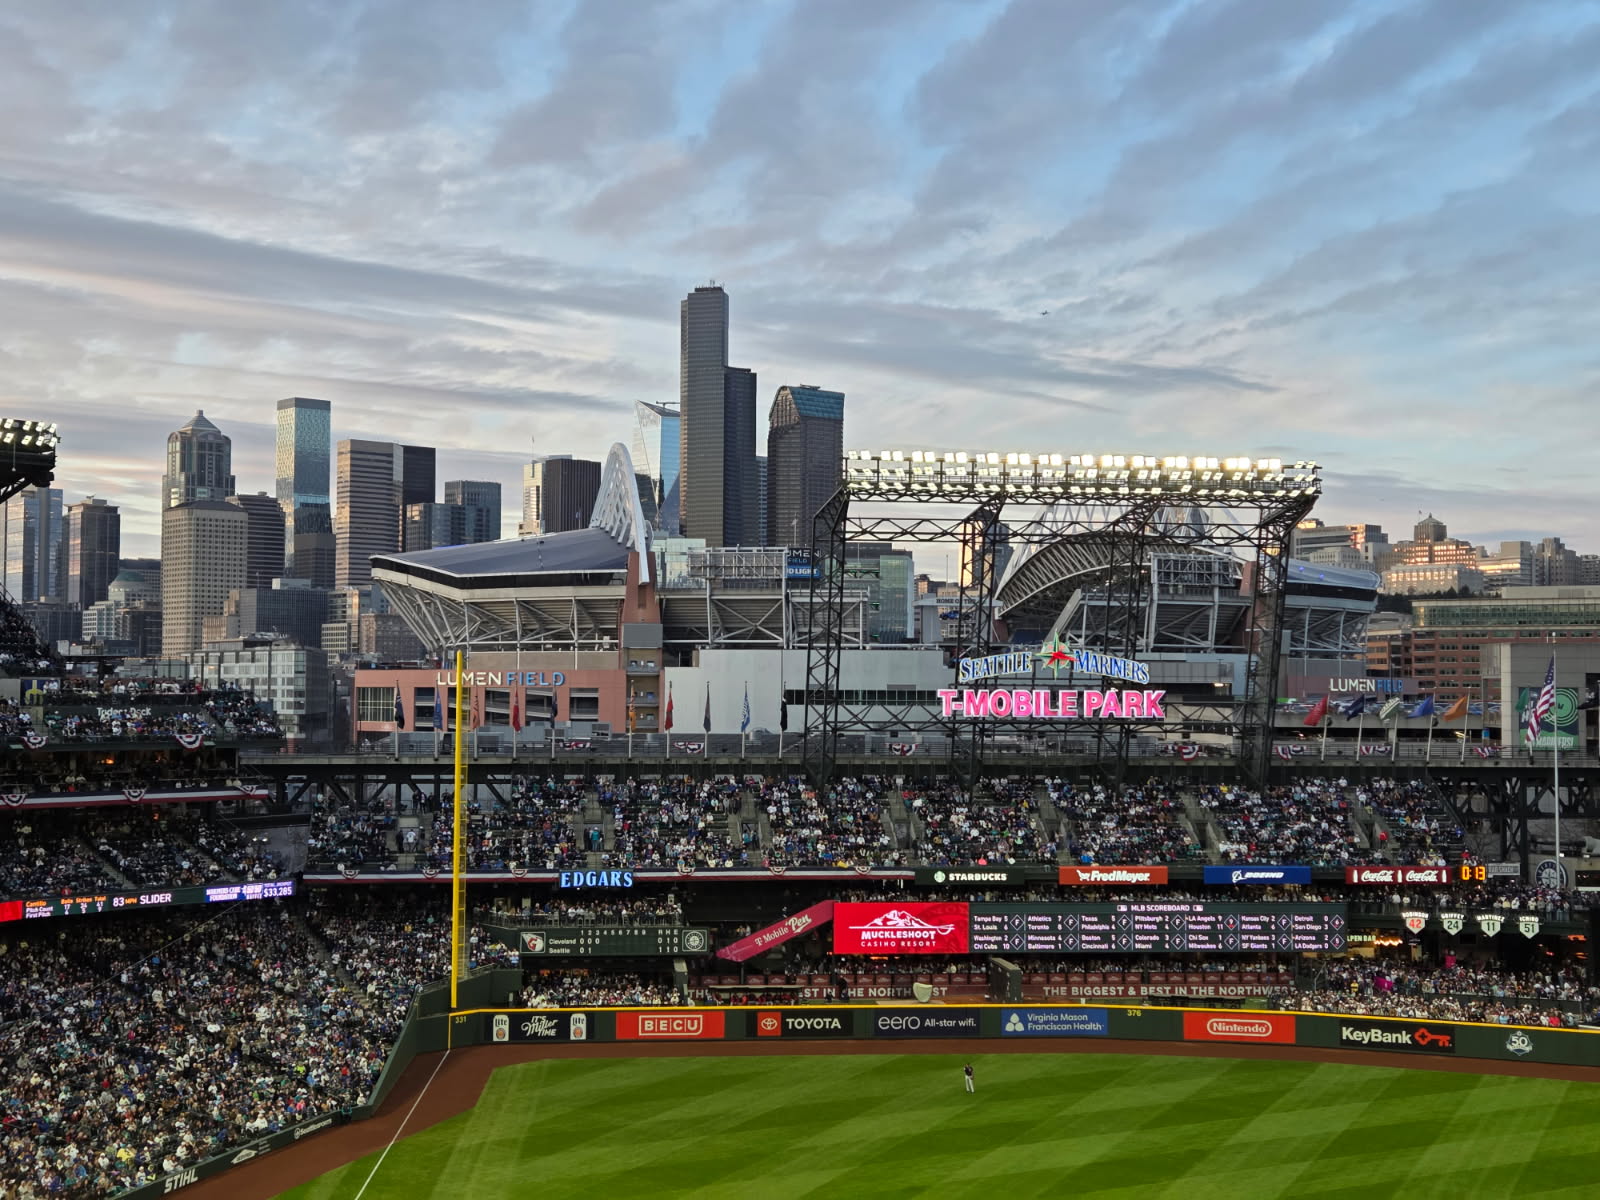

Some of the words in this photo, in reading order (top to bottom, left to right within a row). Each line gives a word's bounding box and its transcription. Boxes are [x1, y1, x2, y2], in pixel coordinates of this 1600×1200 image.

[960, 652, 1032, 683] SEATTLE
[1074, 650, 1150, 684] MARINERS
[437, 672, 502, 686] LUMEN
[506, 672, 565, 686] FIELD
[1330, 678, 1376, 692] LUMEN
[1377, 679, 1403, 693] FIELD
[938, 689, 1078, 718] T-MOBILE
[1084, 689, 1166, 718] PARK
[560, 870, 633, 888] EDGAR'S
[948, 873, 1007, 881] STARBUCKS
[264, 886, 292, 898] $33,285
[112, 897, 124, 907] 83
[140, 893, 172, 905] SLIDER
[1402, 911, 1430, 919] ROBINSON
[1476, 914, 1505, 922] MARTINEZ
[1409, 920, 1422, 928] 42
[1447, 920, 1459, 930] 24
[1486, 922, 1496, 932] 11
[1524, 923, 1536, 933] 51
[762, 926, 789, 944] Mobile
[860, 930, 936, 940] MUCKLESHOOT
[824, 988, 836, 997] IN
[868, 987, 948, 998] NORTHST
[1043, 986, 1068, 996] THE
[1072, 986, 1124, 996] BIGGEST
[1128, 986, 1136, 996] &
[1140, 986, 1171, 996] BEST
[1175, 986, 1188, 995] IN
[1191, 986, 1215, 996] THE
[456, 1016, 467, 1024] 331
[495, 1018, 508, 1028] Lite
[572, 1017, 585, 1026] Lite
[786, 1018, 842, 1030] TOYOTA
[878, 1016, 920, 1030] eero
[924, 1018, 956, 1027] All-star
[958, 1018, 976, 1027] wifi.
[1028, 1014, 1058, 1023] Virginia
[521, 1020, 558, 1036] Miller
[644, 1020, 698, 1031] BECU
[1028, 1022, 1072, 1030] Franciscan
[1213, 1022, 1267, 1035] Nintendo
[1342, 1026, 1412, 1045] KeyBank
[1512, 1036, 1528, 1046] 50
[164, 1169, 198, 1194] STIHL
